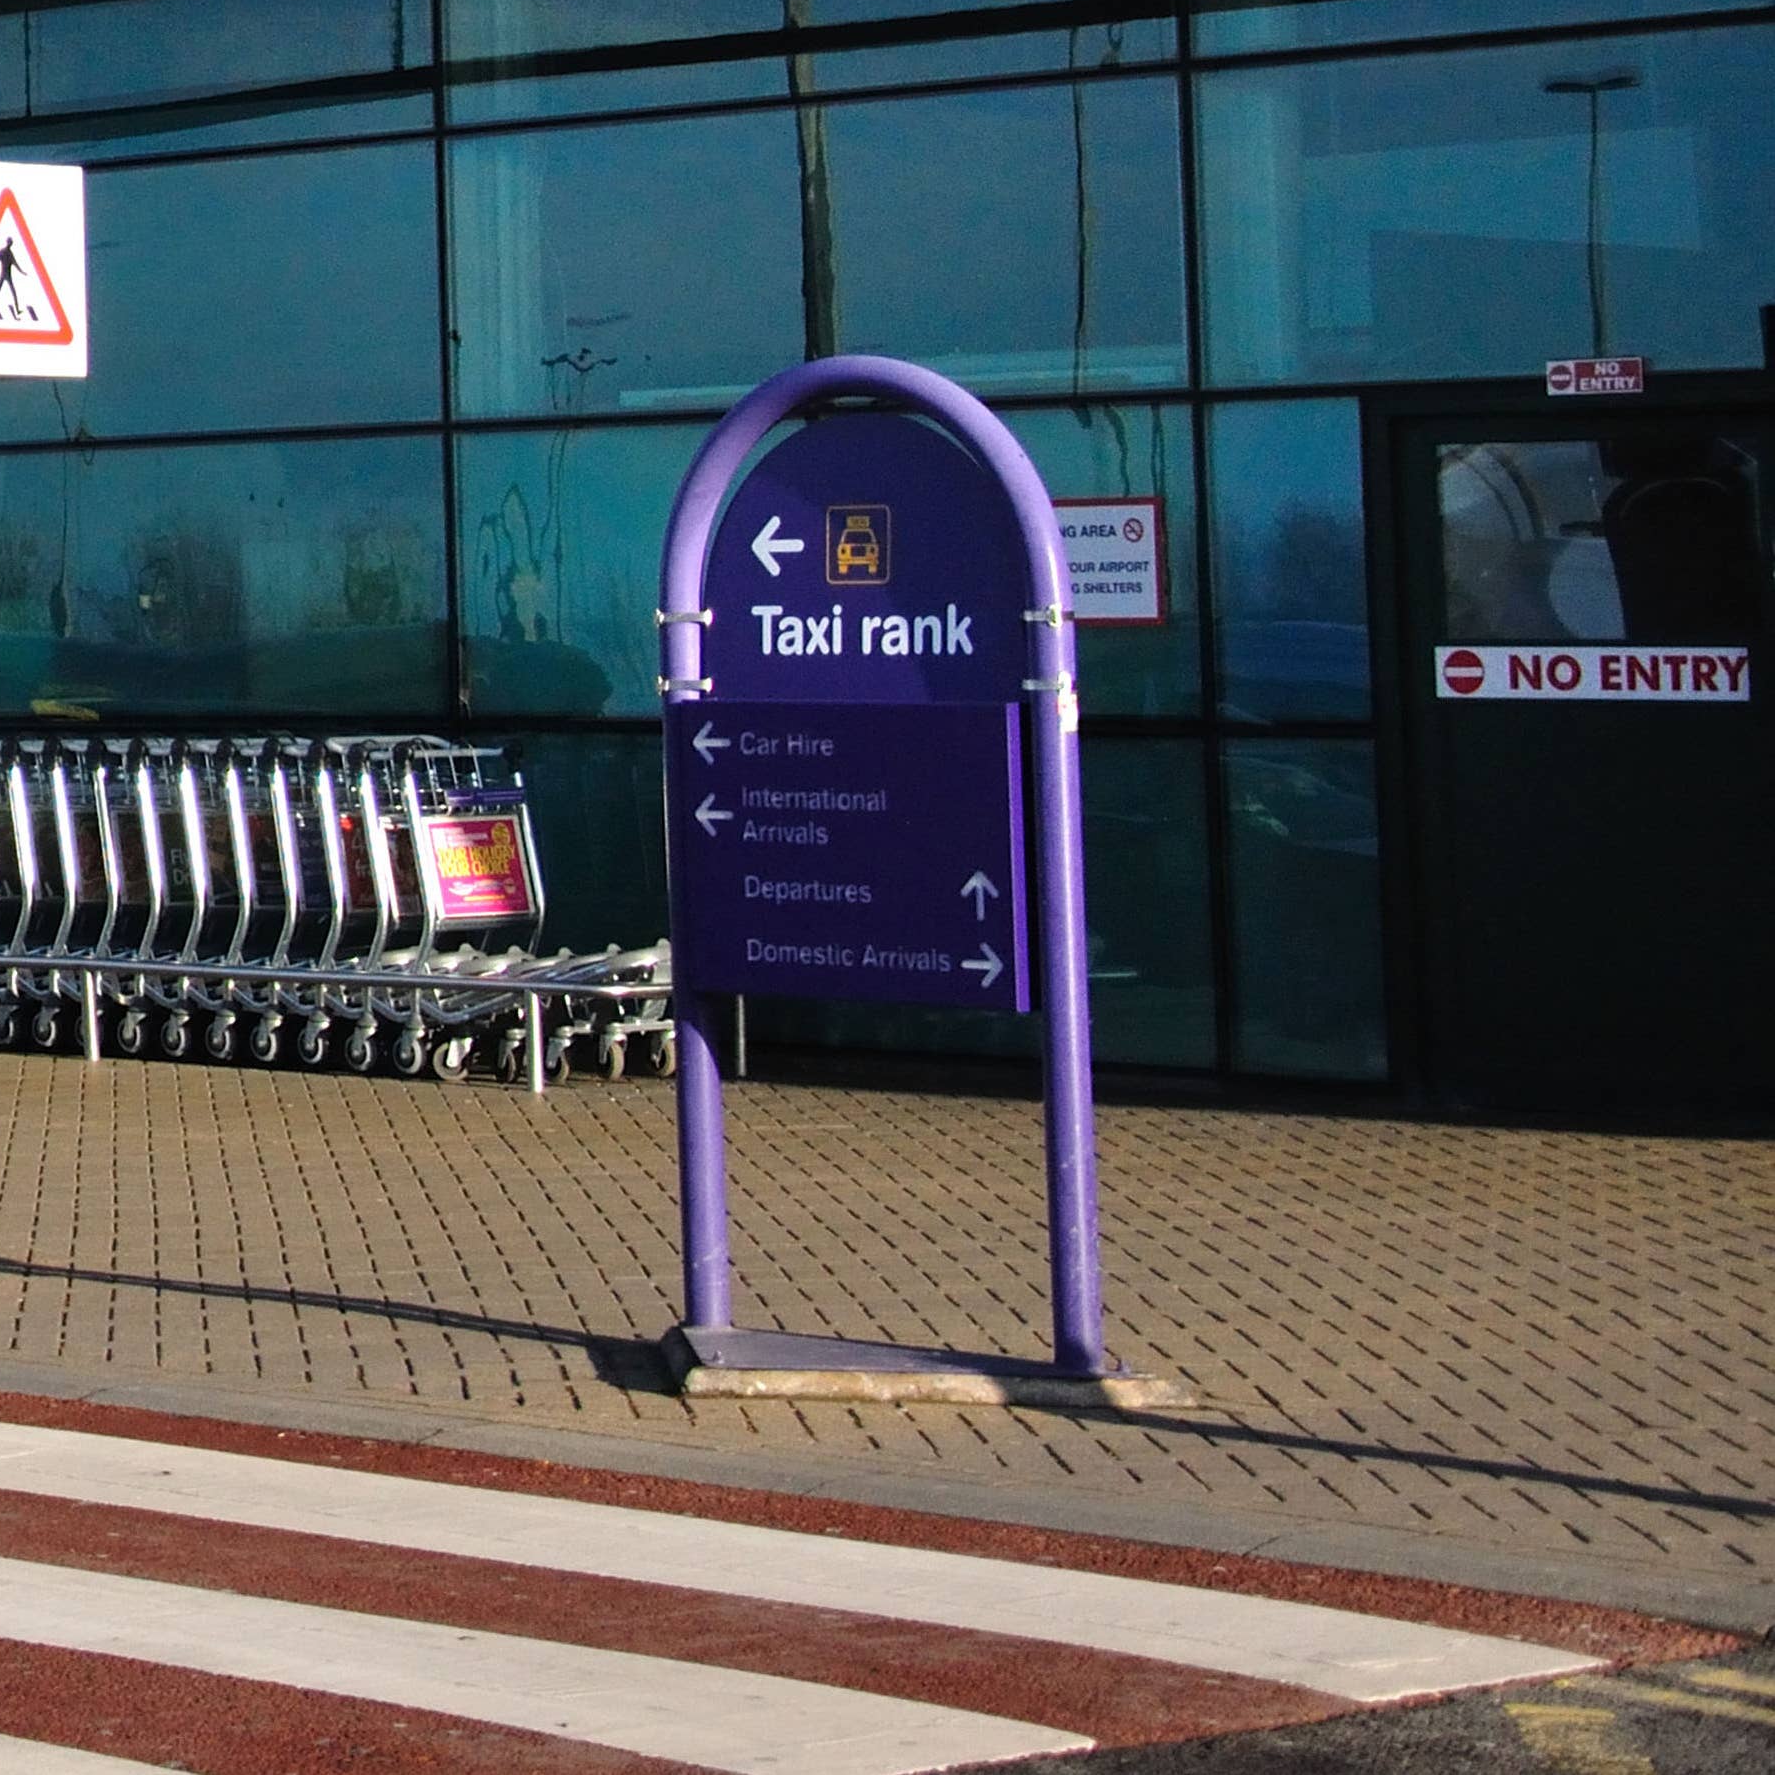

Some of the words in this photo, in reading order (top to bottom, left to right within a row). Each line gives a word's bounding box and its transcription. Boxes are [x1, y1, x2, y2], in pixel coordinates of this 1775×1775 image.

[1594, 362, 1620, 375] NO
[1580, 376, 1636, 391] ENTRY
[1080, 525, 1117, 537] AREA
[1068, 562, 1095, 573] OUR
[1099, 561, 1149, 572] AIRPORT
[1084, 582, 1142, 594] SHELTERS
[751, 604, 842, 656] Taxi
[862, 603, 974, 656] rank
[1509, 654, 1582, 691] NO
[1600, 654, 1748, 692] ENTRY
[740, 731, 779, 756] Car
[787, 733, 835, 757] Hire
[742, 786, 887, 812] International
[743, 820, 829, 846] Arrivals
[744, 874, 873, 905] Departures
[747, 938, 854, 967] Domestic
[862, 943, 951, 973] Arrivals
